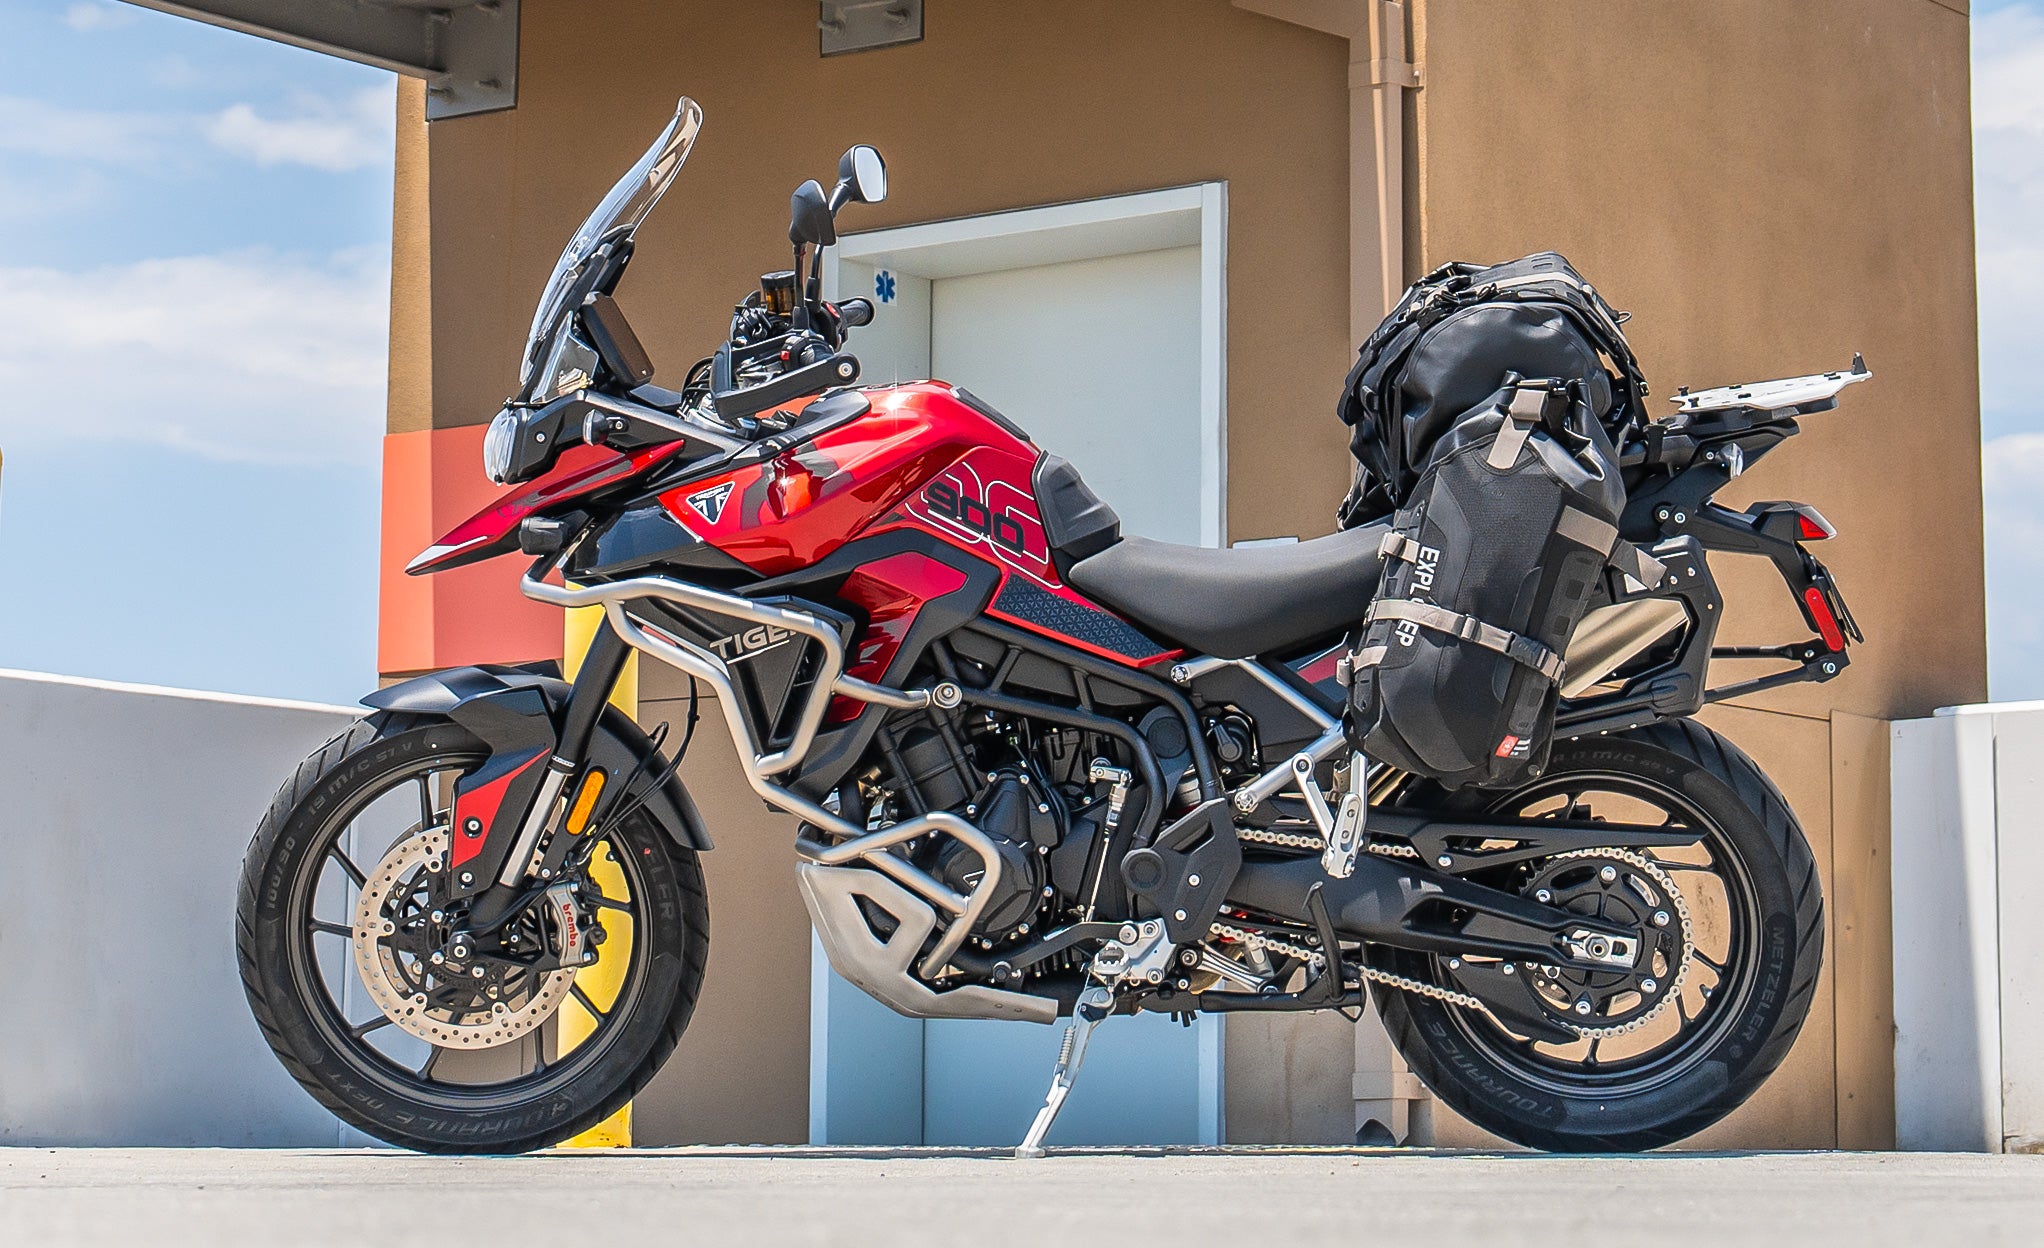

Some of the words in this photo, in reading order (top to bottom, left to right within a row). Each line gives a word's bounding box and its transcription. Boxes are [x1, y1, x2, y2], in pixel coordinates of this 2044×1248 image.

[926, 480, 1025, 554] 900
[1409, 545, 1440, 604] EXPL
[709, 623, 797, 659] TIGE
[308, 795, 328, 816] 19
[562, 903, 579, 947] brembo
[1741, 926, 1785, 1042] METZELER
[1425, 1021, 1554, 1119] TOURANCE
